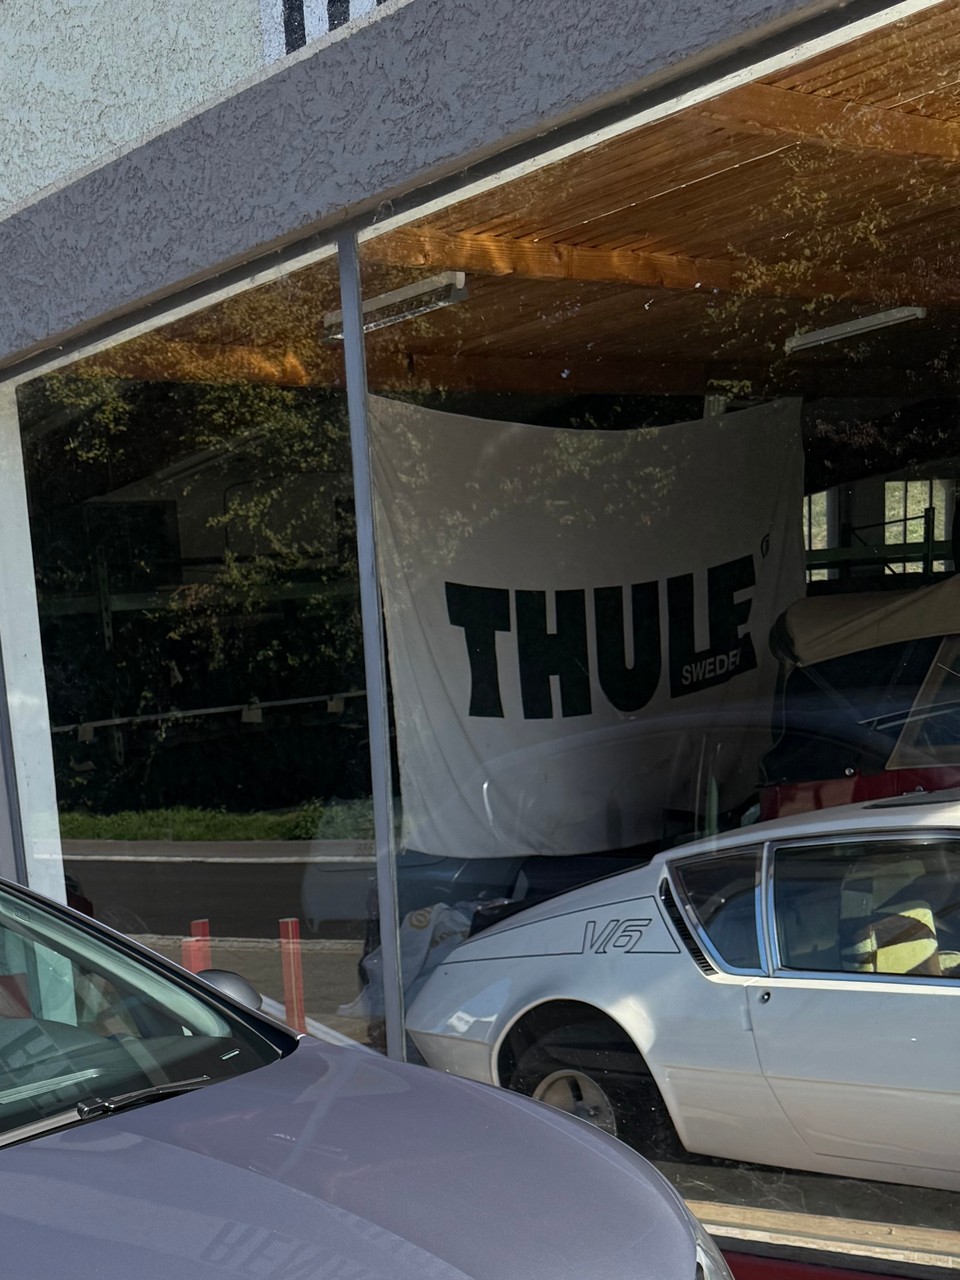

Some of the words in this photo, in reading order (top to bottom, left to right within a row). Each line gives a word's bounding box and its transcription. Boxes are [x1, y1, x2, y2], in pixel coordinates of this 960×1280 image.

[444, 554, 757, 720] THULE
[681, 647, 742, 686] SWEDE
[582, 918, 653, 954] V6
